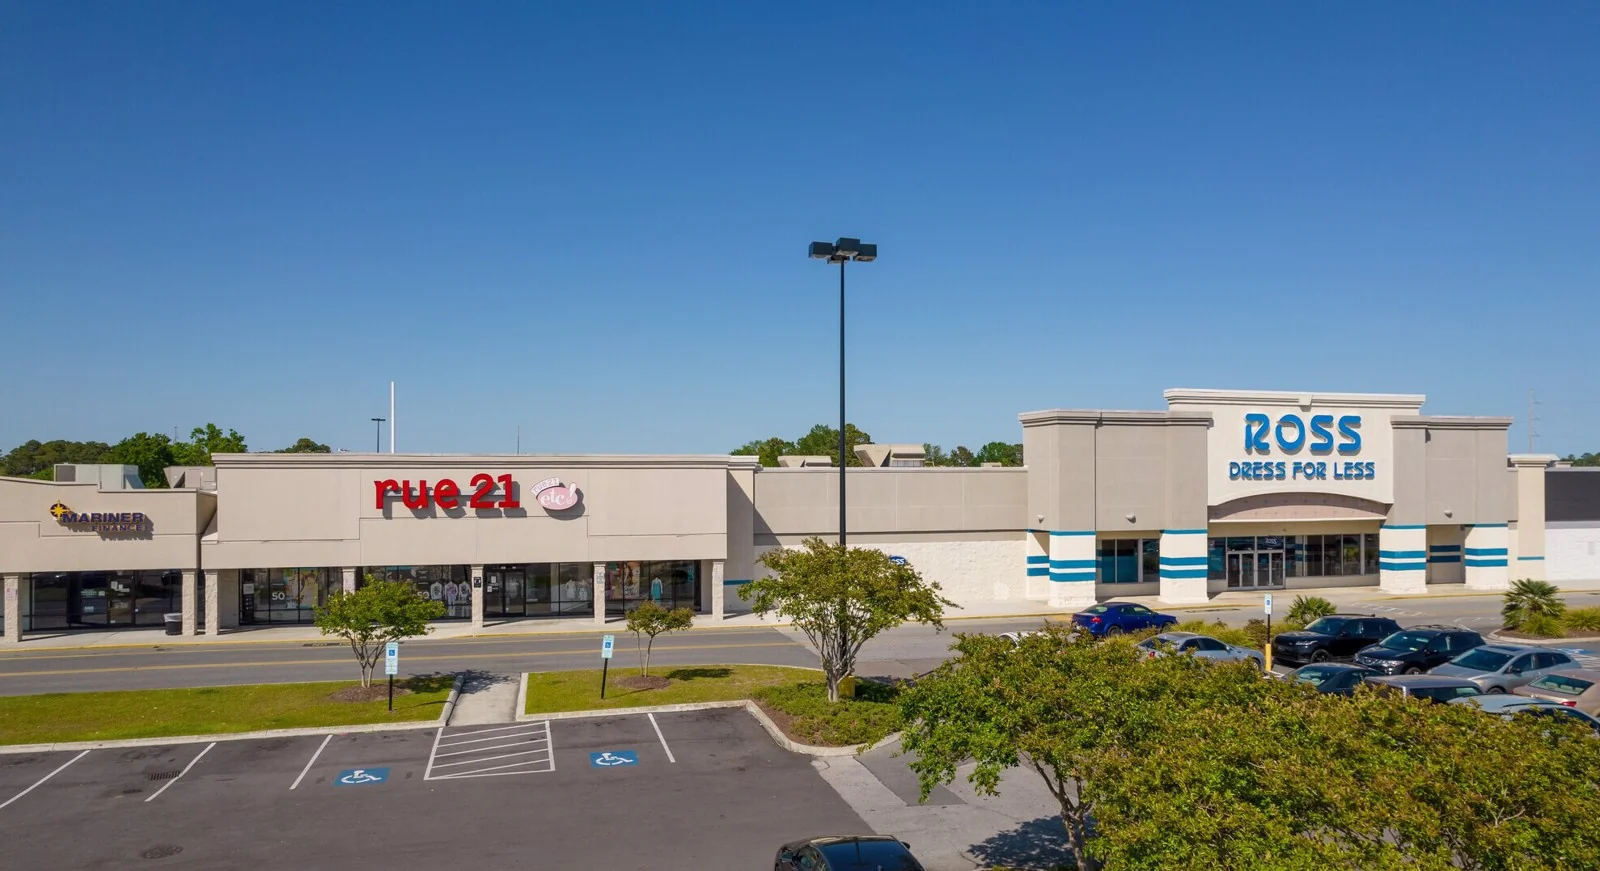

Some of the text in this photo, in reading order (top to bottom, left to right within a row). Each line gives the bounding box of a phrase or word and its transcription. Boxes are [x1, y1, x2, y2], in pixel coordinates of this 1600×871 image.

[1245, 413, 1361, 451] ROSS
[1229, 461, 1375, 479] DRESS FOR LESS
[62, 512, 145, 523] MARINER
[91, 524, 144, 532] FINANCE
